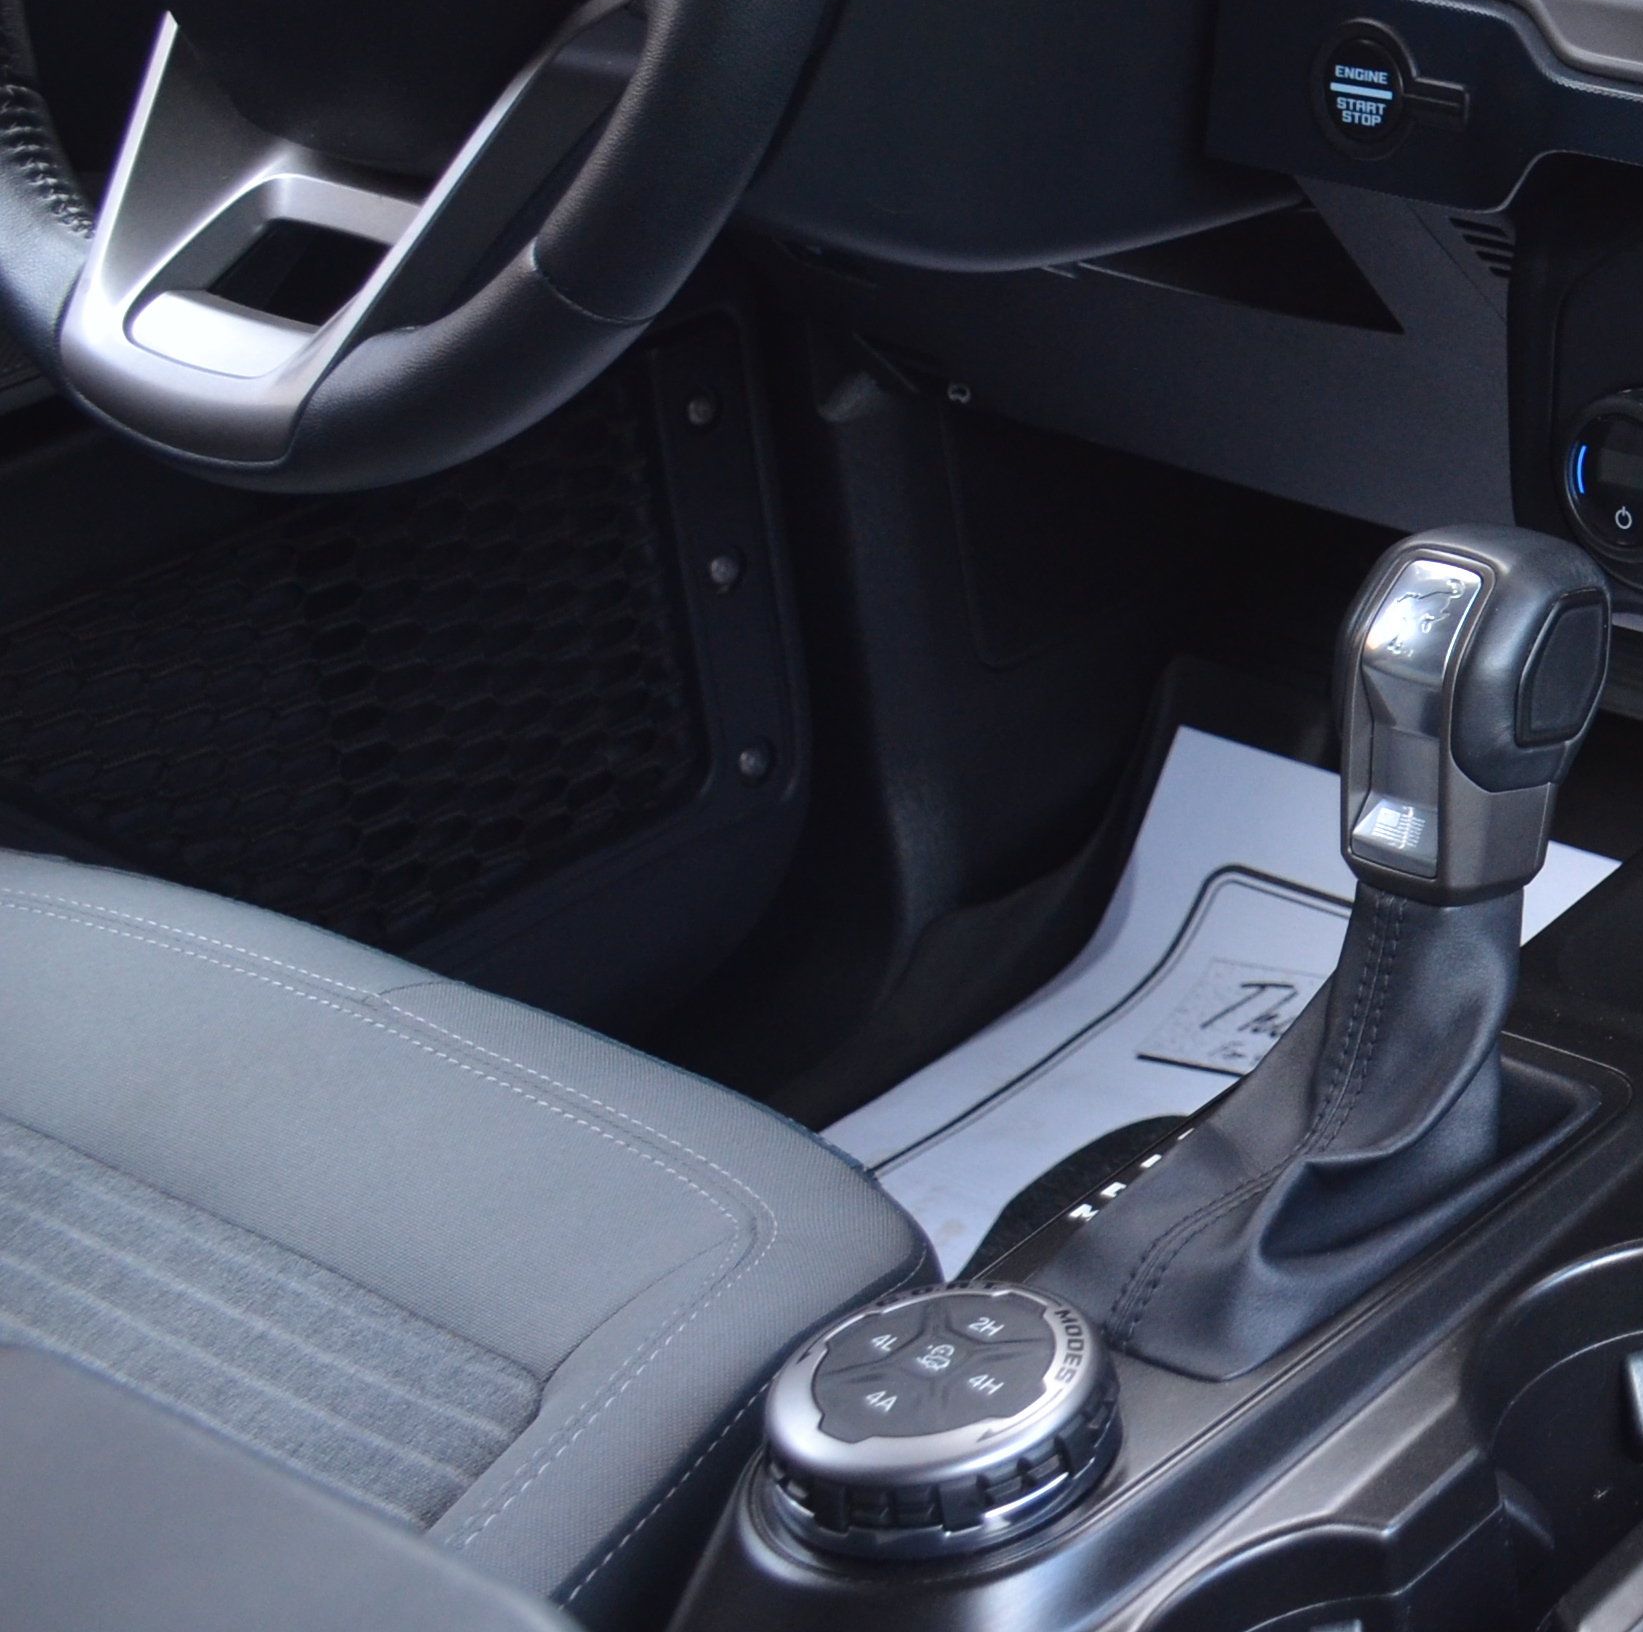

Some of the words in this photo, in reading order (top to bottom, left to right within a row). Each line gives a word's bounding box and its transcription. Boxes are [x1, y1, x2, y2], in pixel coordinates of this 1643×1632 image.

[1335, 65, 1389, 85] ENGINE
[1336, 96, 1387, 116] START
[1342, 111, 1382, 127] STOP
[967, 1316, 1005, 1338] 2H
[871, 1333, 900, 1353] 4L
[1054, 1306, 1085, 1385] MODES
[967, 1373, 1005, 1397] 4H
[865, 1390, 898, 1413] 4A
